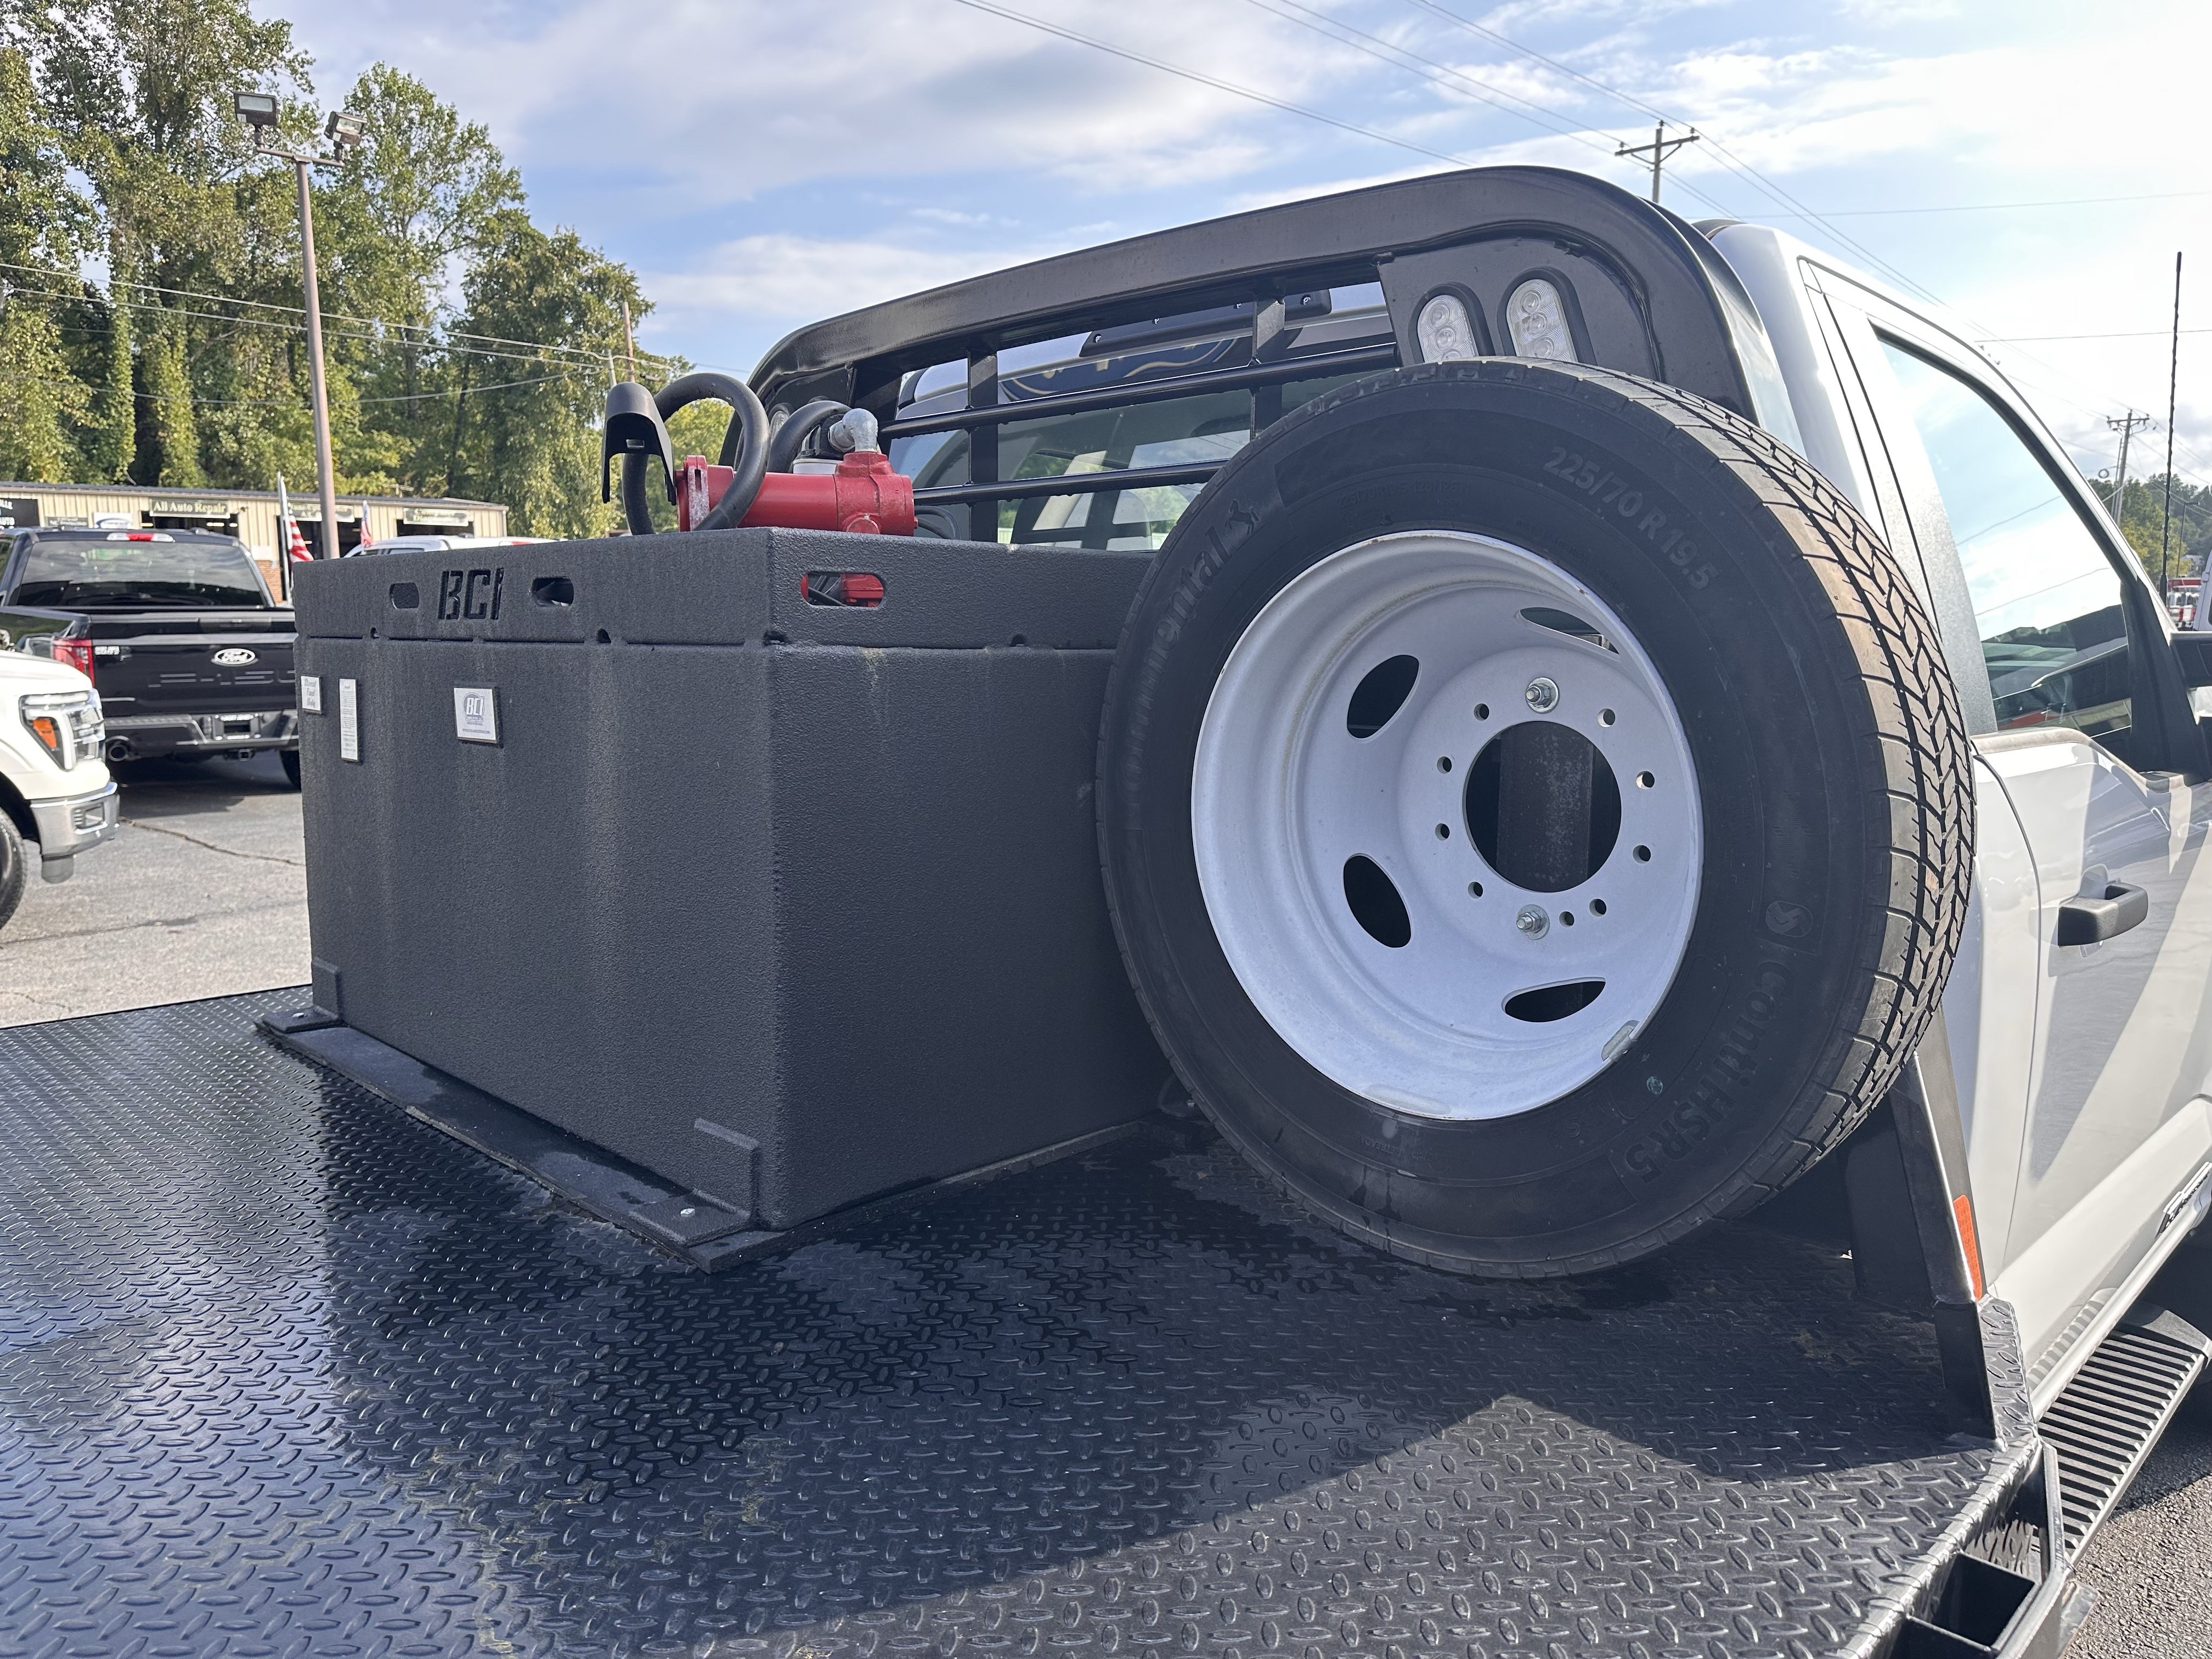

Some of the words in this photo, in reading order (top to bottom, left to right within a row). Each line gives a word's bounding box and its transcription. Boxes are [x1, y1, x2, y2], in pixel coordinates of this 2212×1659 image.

[154, 501, 168, 511] All
[170, 501, 193, 512] Auto
[194, 502, 226, 514] Repair
[1543, 446, 1643, 517] 225/70
[1638, 506, 1667, 540] R
[1660, 528, 1720, 590] 19.5
[438, 567, 504, 620] BCI
[466, 697, 483, 716] BCI
[1712, 961, 1797, 1088] Conti
[1647, 1075, 1736, 1160] HSR
[1625, 1143, 1662, 1184] 5
